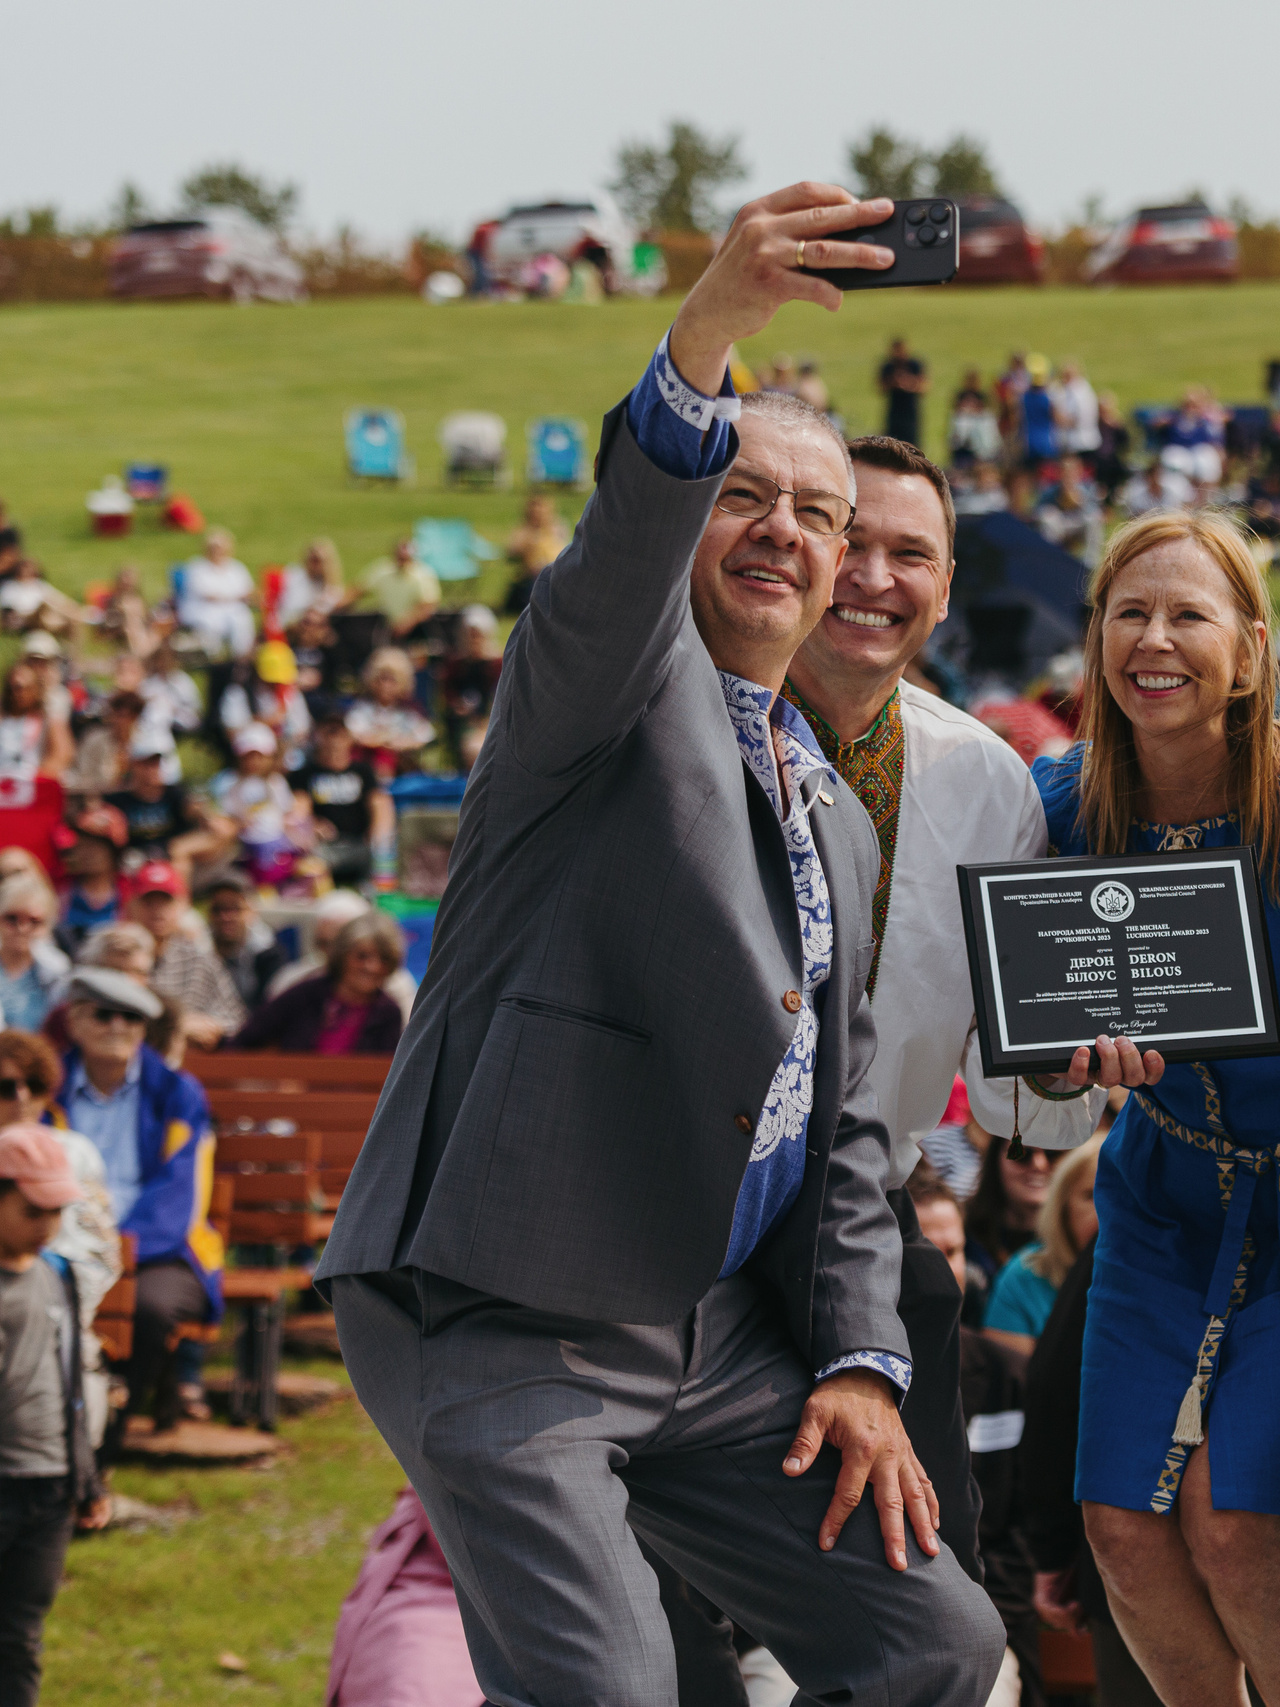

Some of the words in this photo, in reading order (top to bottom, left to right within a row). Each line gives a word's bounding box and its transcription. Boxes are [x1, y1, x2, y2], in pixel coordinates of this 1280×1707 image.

[1075, 927, 1110, 935] МИХАЙЛА
[1126, 931, 1170, 939] LUCHKOVICH
[1070, 956, 1114, 970] ДЕРОН
[1129, 952, 1176, 964] DERON
[1065, 970, 1117, 983] БІЛОУС
[1131, 966, 1182, 978] BILOUS
